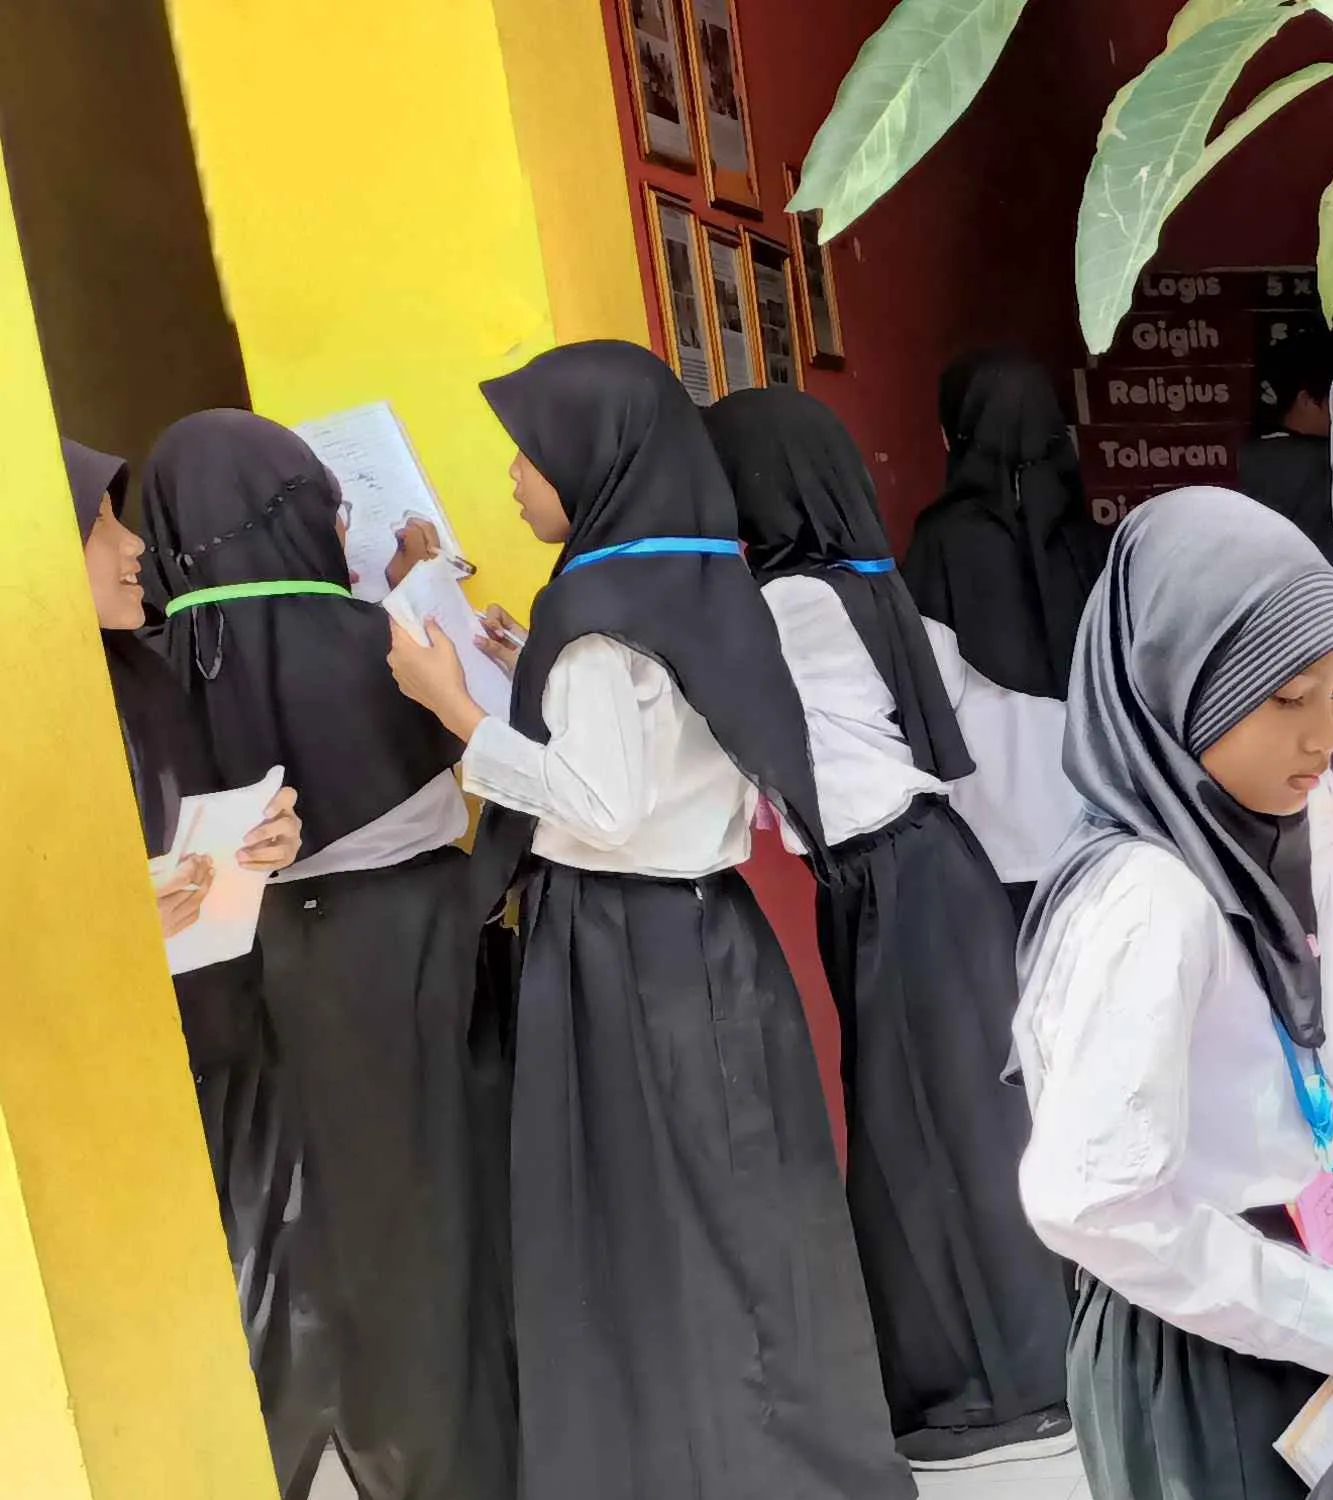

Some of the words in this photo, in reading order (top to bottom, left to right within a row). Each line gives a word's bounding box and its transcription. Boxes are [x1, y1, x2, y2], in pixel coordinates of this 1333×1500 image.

[1142, 275, 1222, 304] Logis
[1132, 320, 1220, 357] Gigih
[1108, 376, 1230, 412] Religius
[1099, 440, 1227, 468] Toleran
